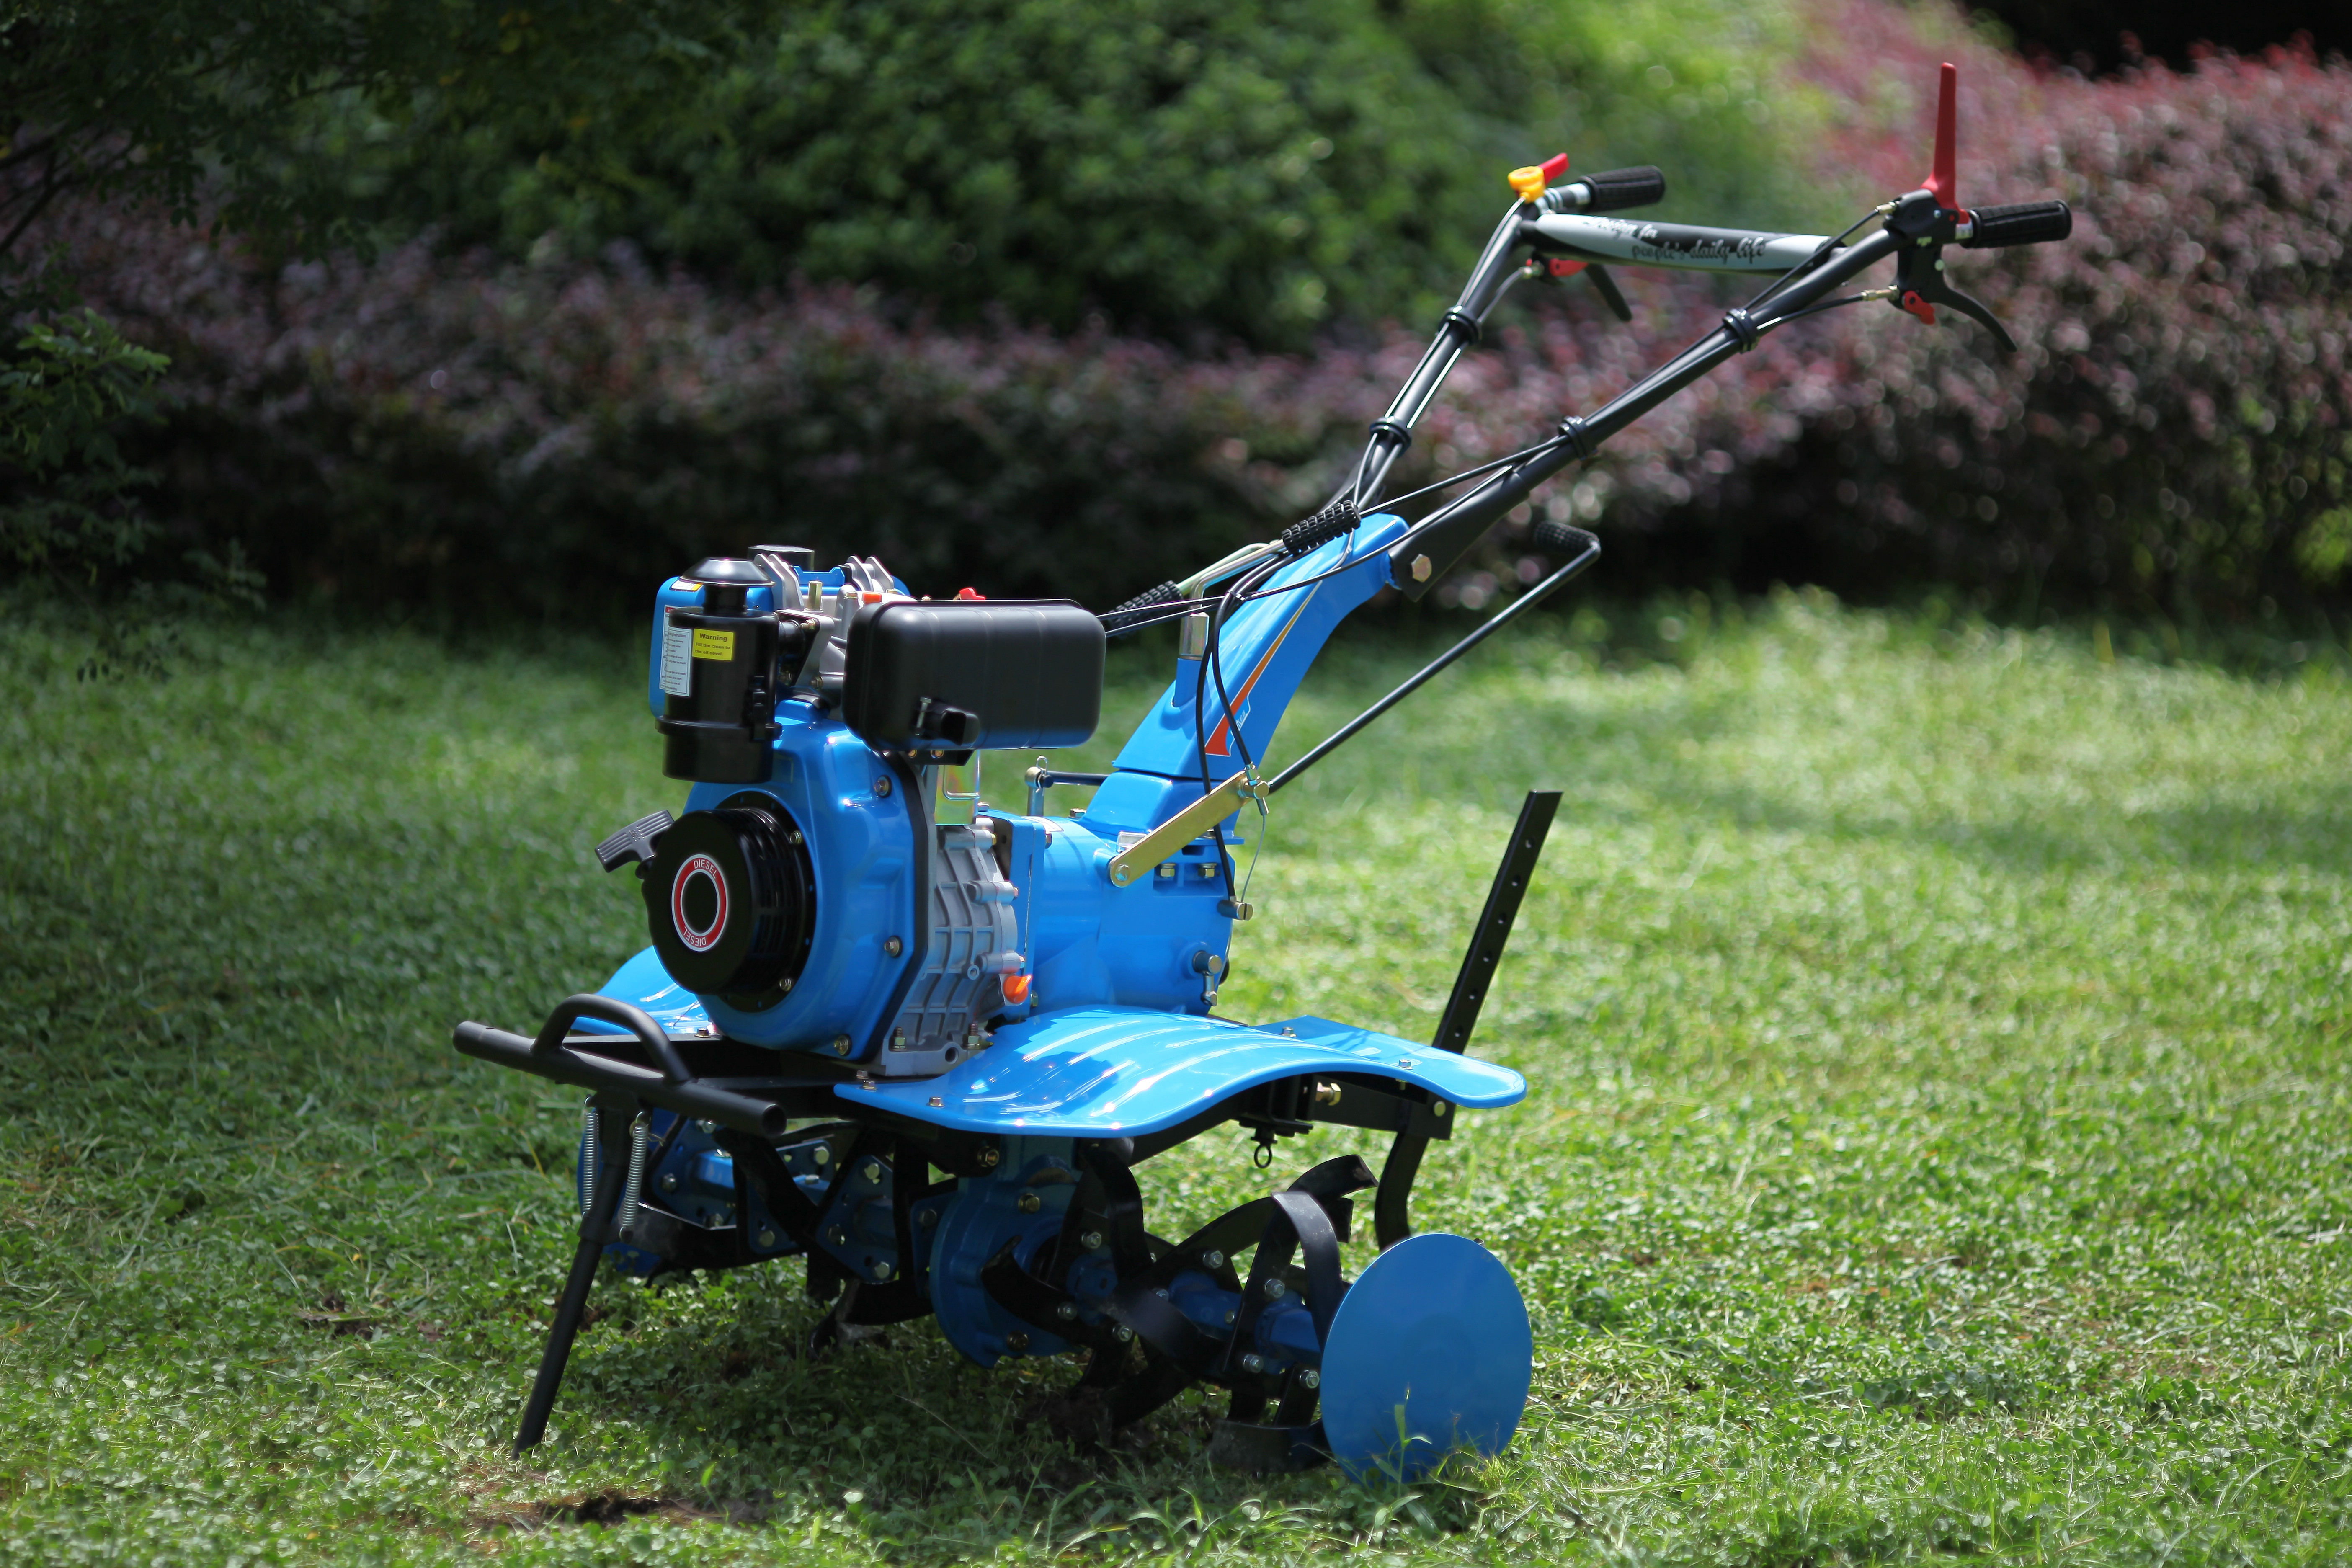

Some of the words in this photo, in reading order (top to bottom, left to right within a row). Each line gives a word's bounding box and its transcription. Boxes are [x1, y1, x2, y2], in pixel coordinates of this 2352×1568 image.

[1632, 241, 1685, 262] people's
[1689, 239, 1730, 264] daily
[1736, 236, 1766, 264] life
[699, 633, 727, 642] Warning
[694, 859, 717, 879] DIESEL
[683, 926, 707, 946] DIESEL
